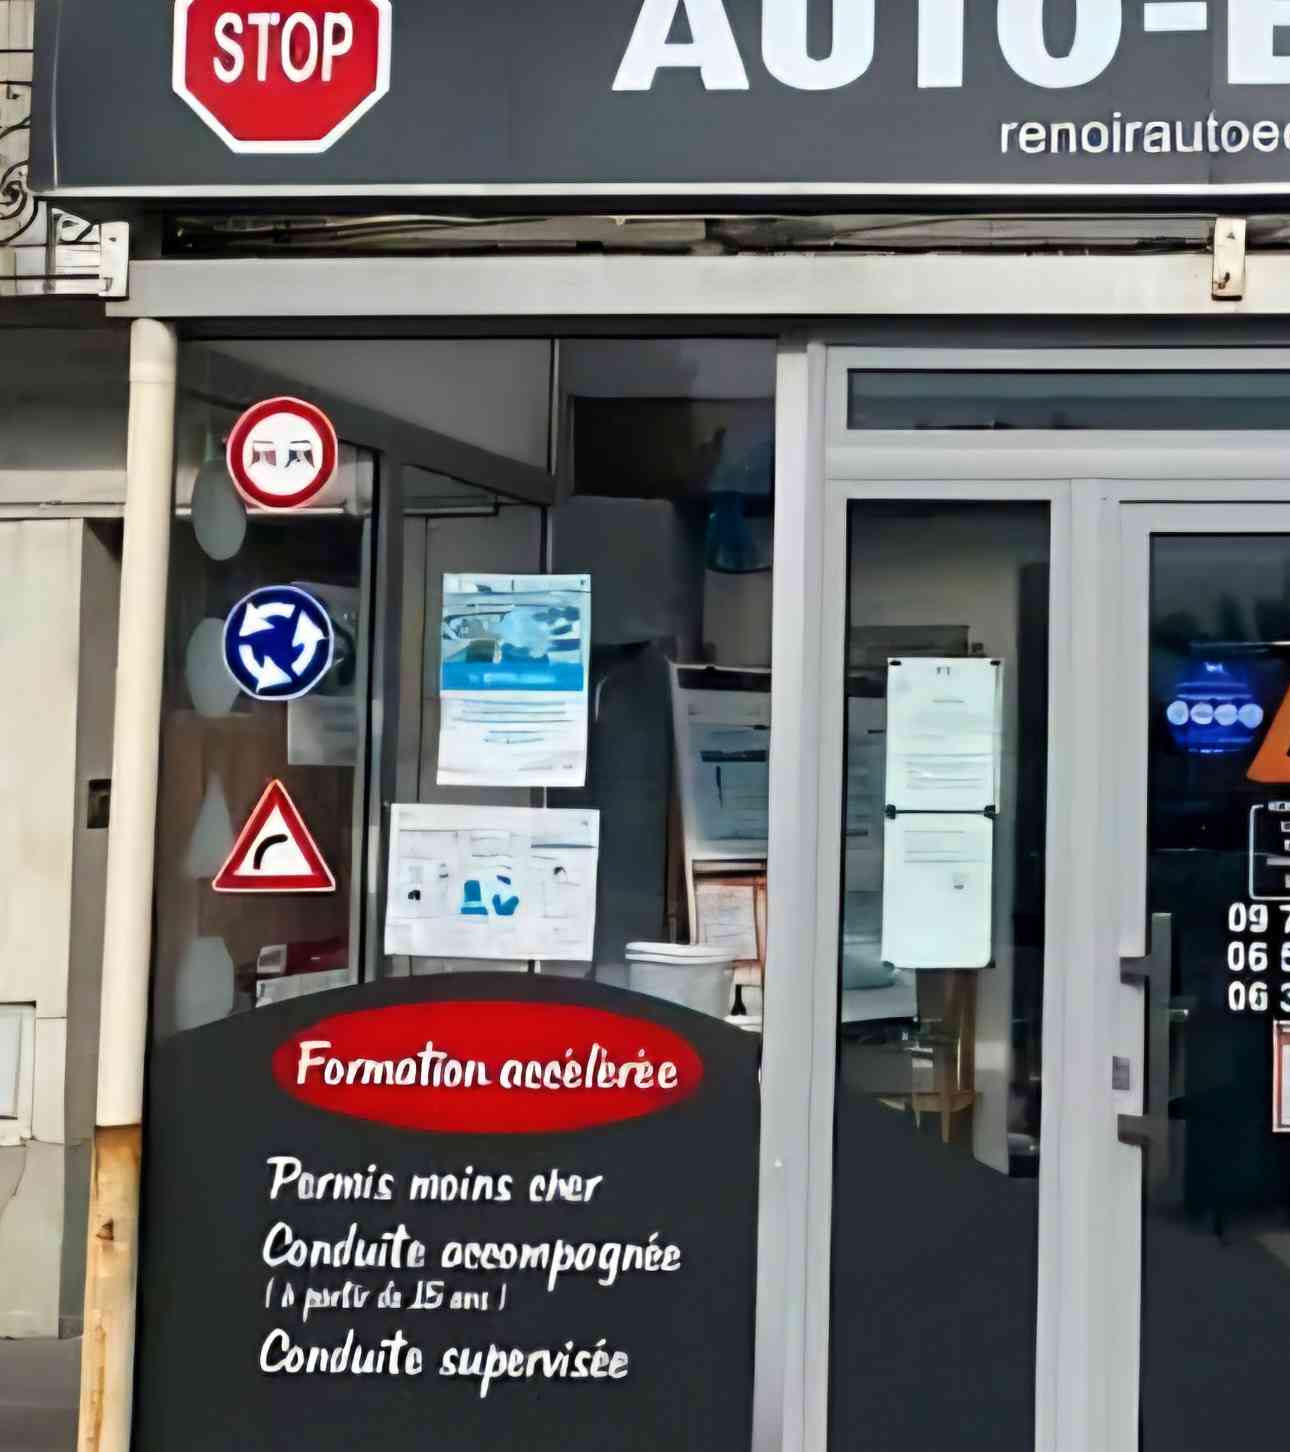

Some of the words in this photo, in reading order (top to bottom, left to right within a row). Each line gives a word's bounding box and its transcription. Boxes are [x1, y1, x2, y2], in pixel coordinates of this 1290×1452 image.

[213, 11, 354, 84] STOP
[1228, 902, 1269, 933] 09
[1227, 940, 1268, 972] 06
[1228, 980, 1268, 1011] 06
[296, 1040, 492, 1088] Formation
[409, 1165, 513, 1202] moins
[528, 1168, 604, 1203] cher
[262, 1221, 426, 1269] Conduite
[440, 1231, 681, 1292] accompagnée
[406, 1279, 445, 1310] 15
[259, 1327, 423, 1376] Conduite
[438, 1338, 629, 1399] supervisée
